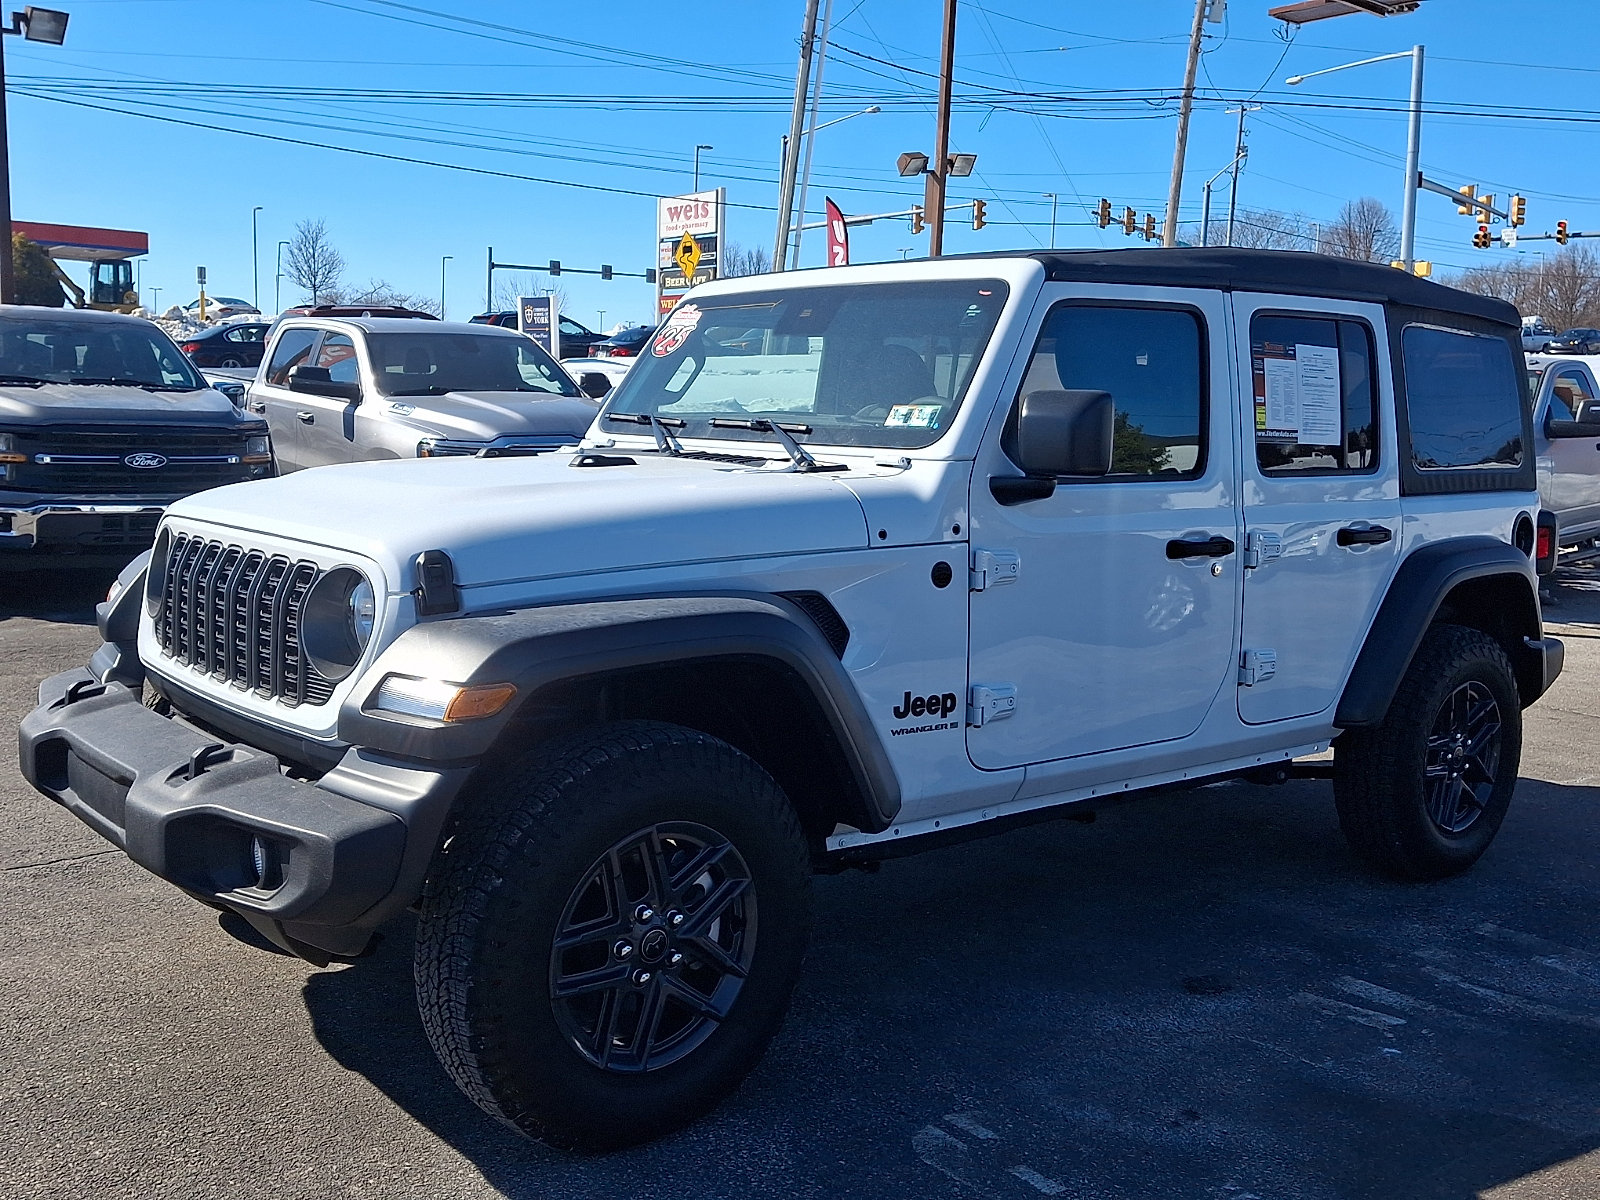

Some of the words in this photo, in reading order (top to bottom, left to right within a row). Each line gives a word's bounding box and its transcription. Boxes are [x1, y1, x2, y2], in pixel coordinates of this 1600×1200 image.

[667, 198, 709, 222] weis
[665, 224, 678, 232] food
[665, 277, 685, 288] BEER
[133, 455, 159, 466] Ford
[893, 691, 957, 719] Jeep
[890, 723, 949, 737] WRANGLER
